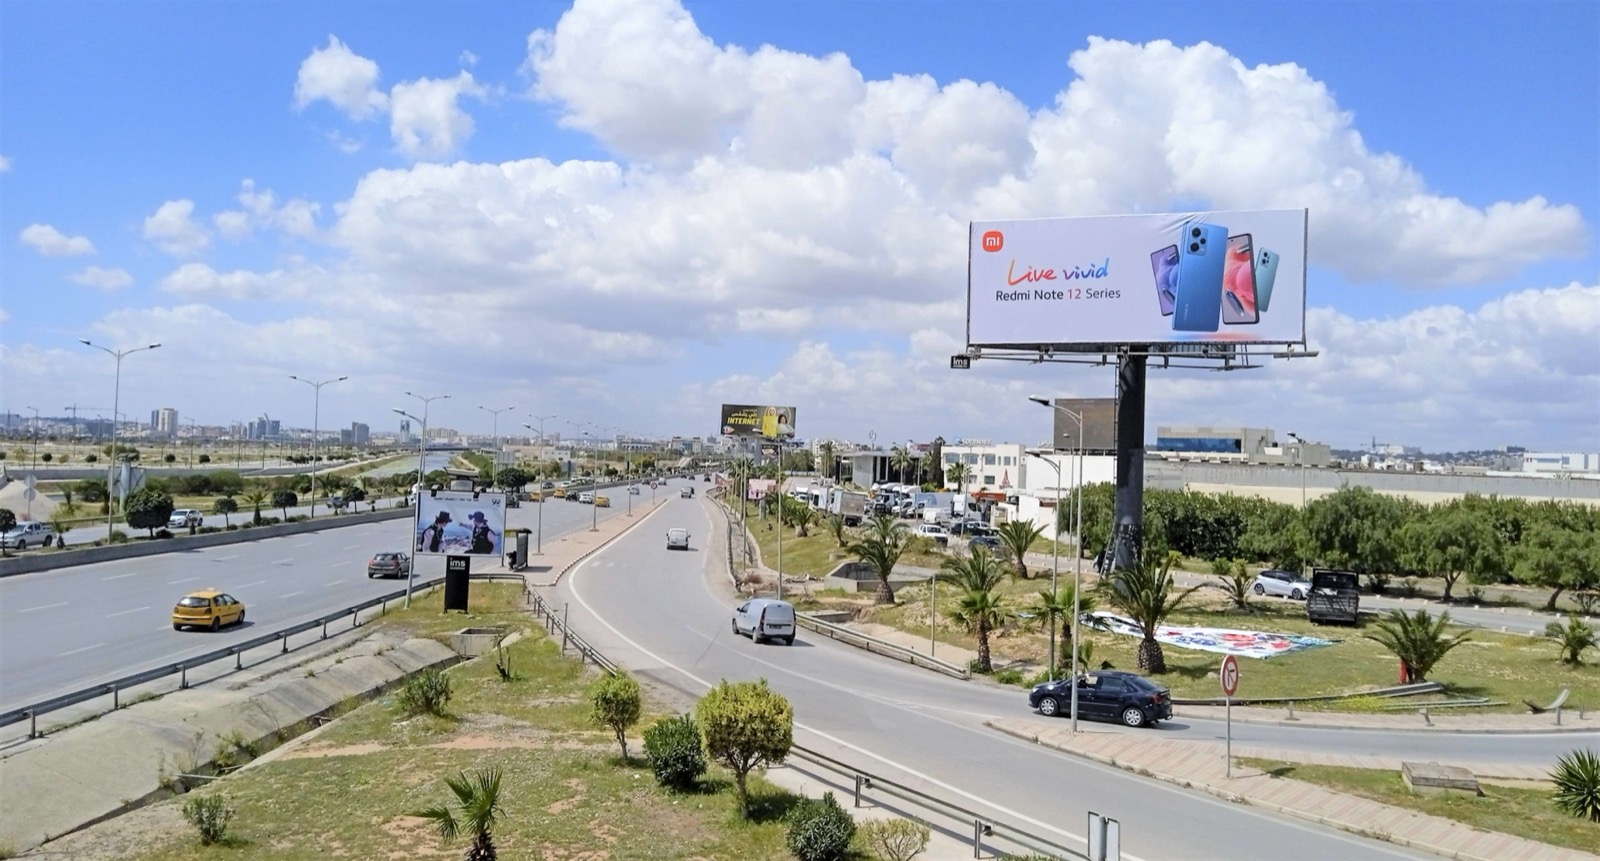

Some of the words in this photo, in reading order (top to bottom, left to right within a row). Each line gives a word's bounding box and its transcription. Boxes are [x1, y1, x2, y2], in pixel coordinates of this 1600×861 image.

[1007, 259, 1057, 286] Live
[1063, 257, 1109, 280] vivid
[996, 290, 1030, 301] Redmi
[1034, 289, 1064, 301] Note
[1068, 288, 1081, 299] 12
[1086, 287, 1121, 299] Series
[727, 416, 760, 425] INTERNET
[450, 557, 465, 567] ims
